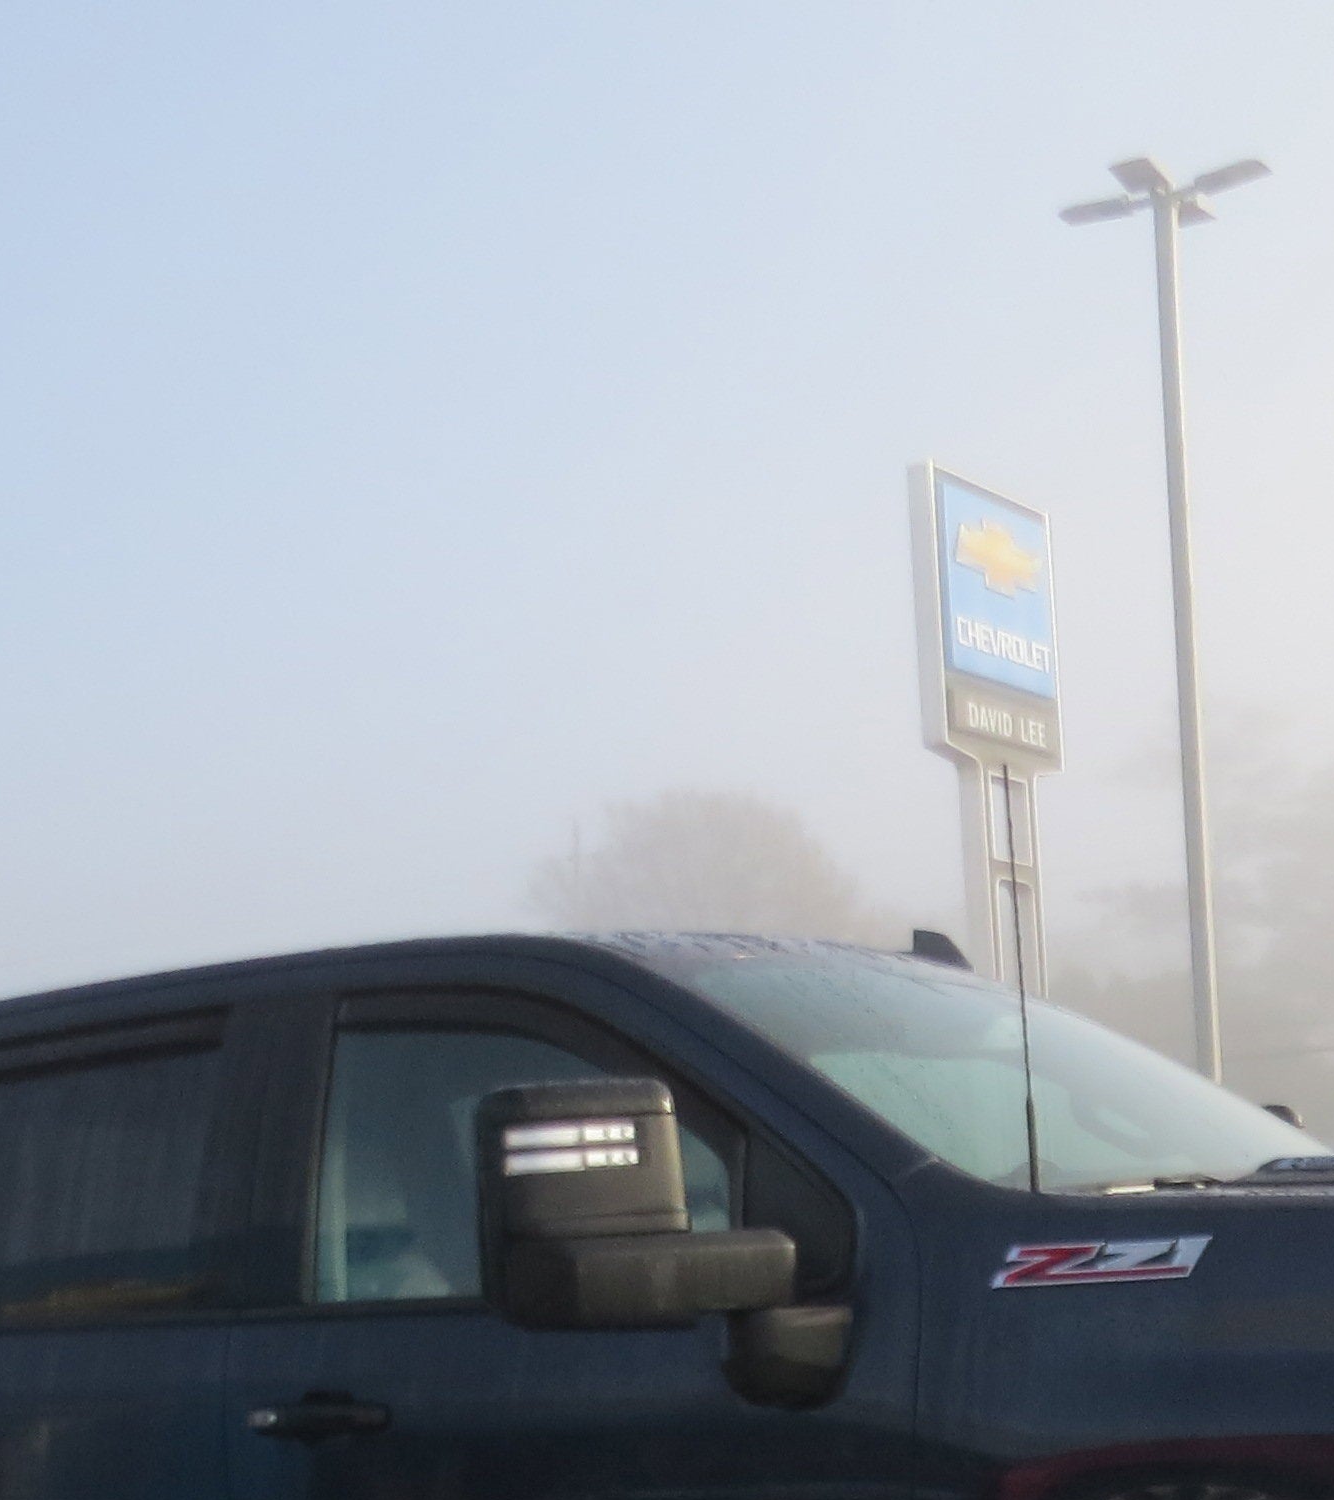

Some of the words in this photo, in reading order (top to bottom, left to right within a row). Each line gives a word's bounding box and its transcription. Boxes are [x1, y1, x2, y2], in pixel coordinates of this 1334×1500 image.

[956, 615, 1051, 674] CHEVROLET
[968, 701, 1013, 738] DAVID
[1020, 717, 1047, 748] LEE
[992, 1234, 1214, 1290] Z71
